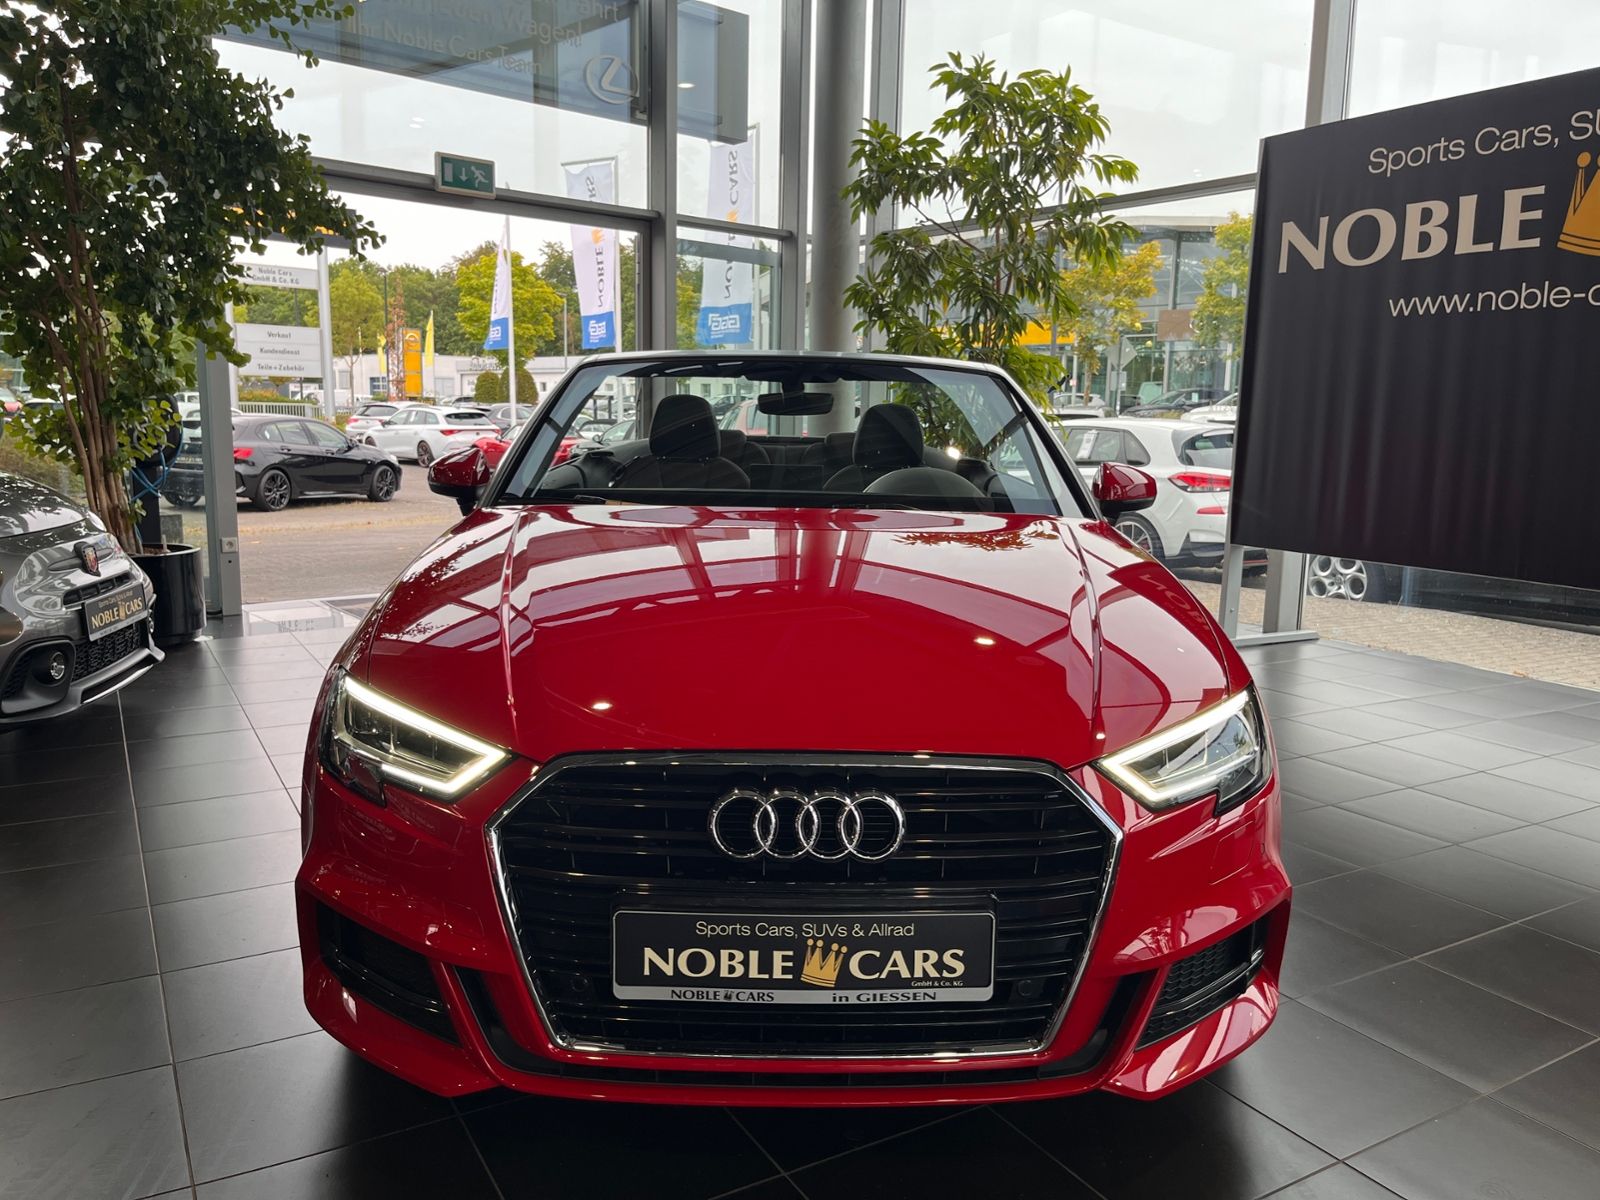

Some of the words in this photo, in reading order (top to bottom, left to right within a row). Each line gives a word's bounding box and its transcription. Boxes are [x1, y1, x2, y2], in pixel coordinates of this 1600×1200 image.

[384, 20, 444, 53] Noble
[448, 35, 493, 61] Cars
[1368, 138, 1465, 178] Sports
[1474, 123, 1559, 155] Cars,
[1569, 108, 1600, 140] S
[1278, 184, 1545, 275] NOBLE
[91, 607, 120, 629] NOBLE
[125, 597, 143, 615] CARS
[695, 920, 751, 938] Sports
[755, 922, 799, 940] Cars,
[801, 922, 848, 937] SUVs
[851, 923, 865, 937] &
[868, 922, 915, 937] Allrad
[643, 947, 794, 979] NOBLE
[848, 949, 966, 980] CARS
[670, 989, 721, 1001] NOBLE
[735, 991, 775, 1002] CARS
[831, 992, 849, 1003] in
[856, 991, 937, 1003] GIESSEN
